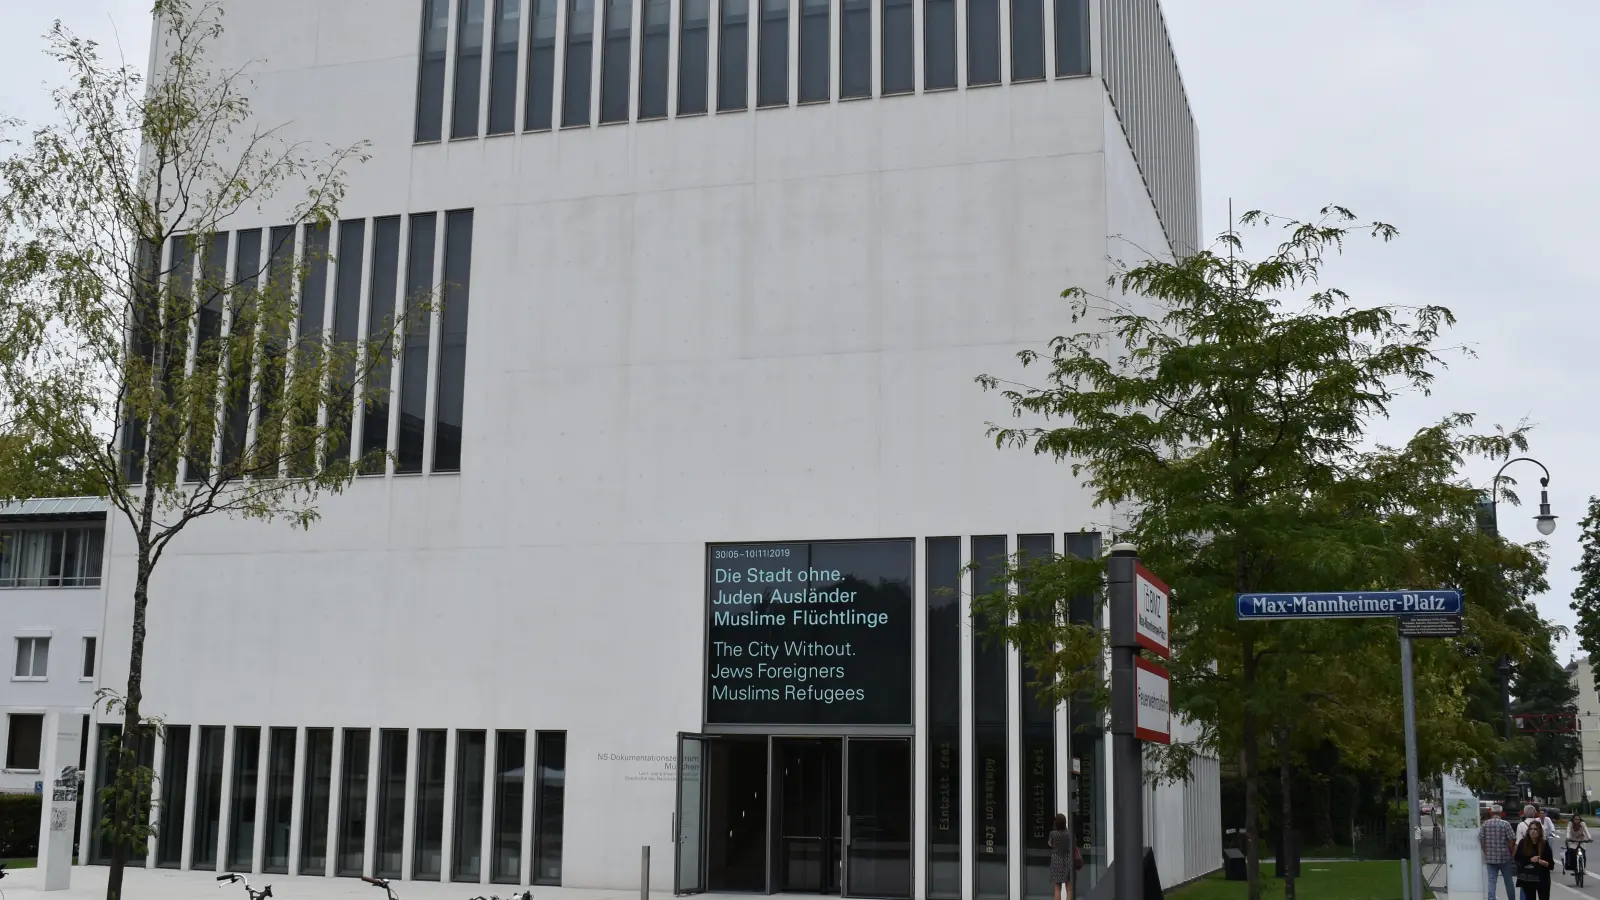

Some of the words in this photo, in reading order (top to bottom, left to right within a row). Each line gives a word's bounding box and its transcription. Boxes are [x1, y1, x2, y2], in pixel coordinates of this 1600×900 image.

[715, 568, 742, 583] Die
[747, 567, 793, 583] Stadt
[797, 567, 846, 582] ohne.
[713, 589, 763, 605] Juden
[770, 587, 857, 604] Ausländer
[1252, 594, 1446, 614] Max-Mannheimer-Platz
[714, 611, 786, 626] Muslime
[793, 609, 889, 628] Flüchtlinge
[713, 641, 743, 657] The
[748, 641, 779, 660] City
[784, 640, 856, 656] Without.
[711, 663, 753, 679] Jews
[758, 663, 845, 681] Foreigners
[712, 684, 780, 700] Muslims
[785, 684, 865, 704] Refugees
[664, 762, 699, 770] Müchen
